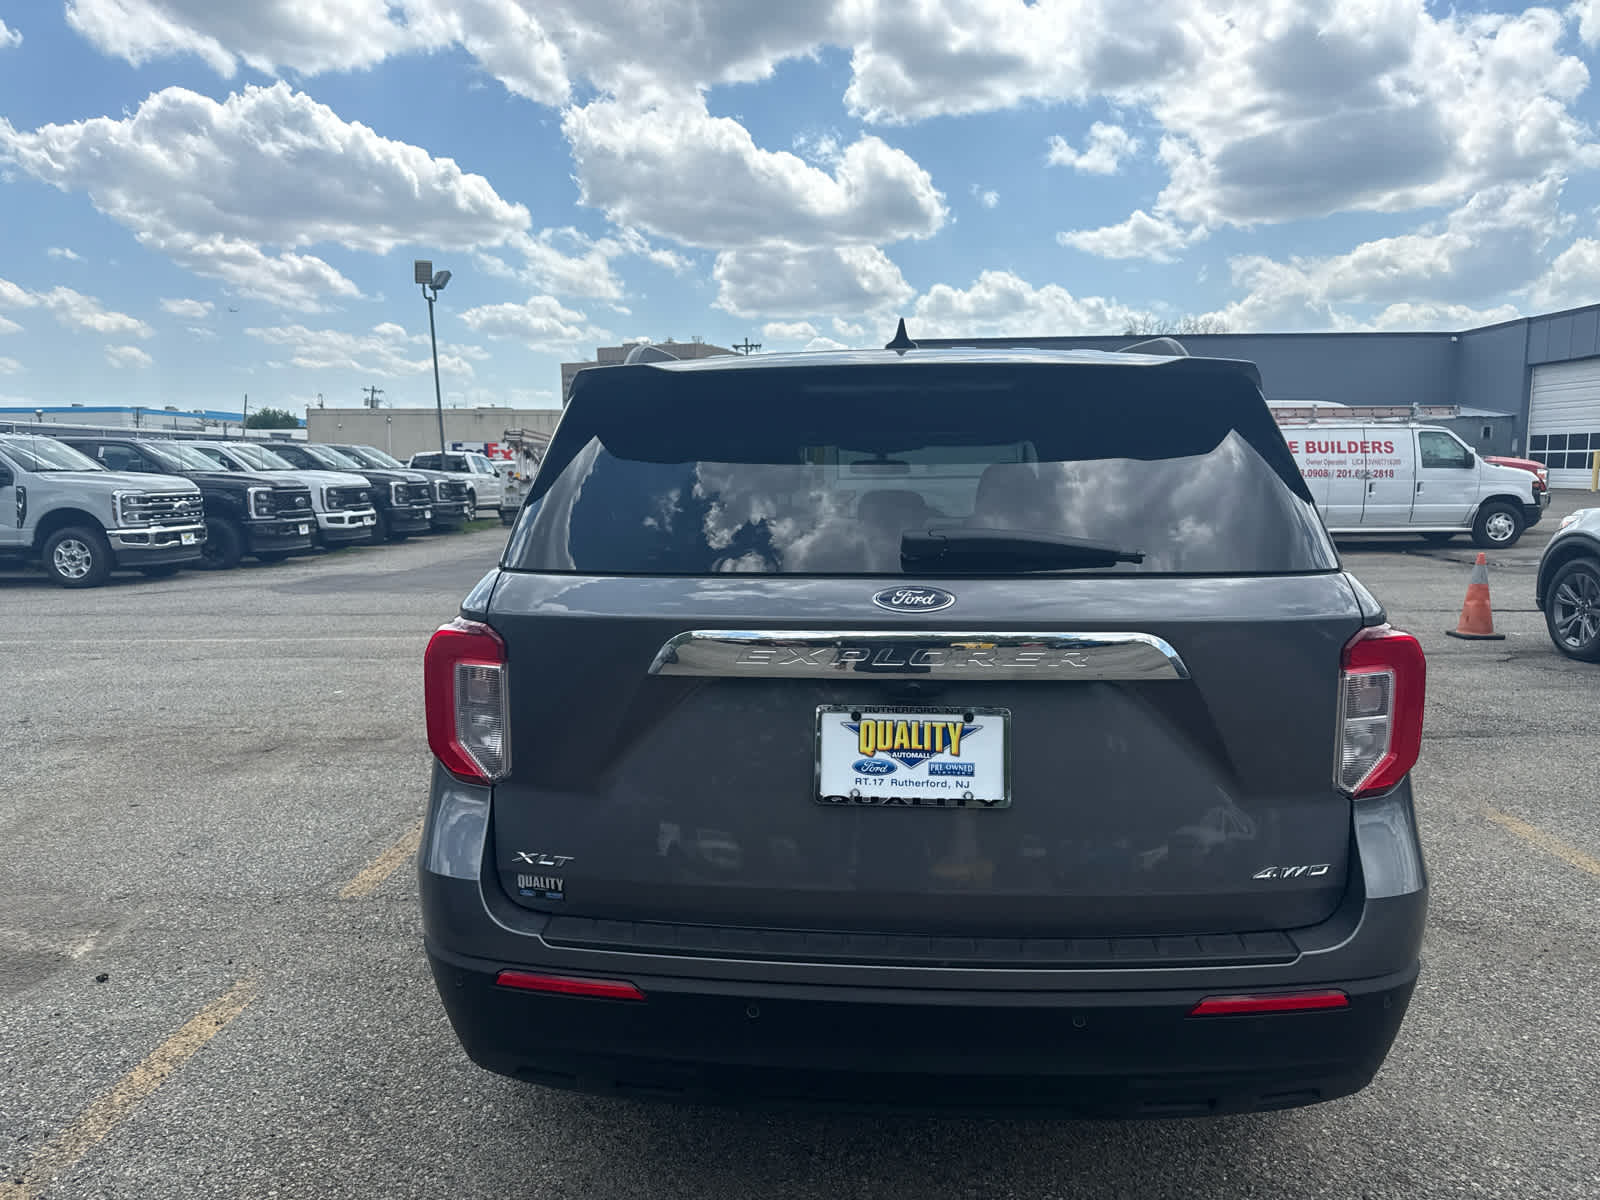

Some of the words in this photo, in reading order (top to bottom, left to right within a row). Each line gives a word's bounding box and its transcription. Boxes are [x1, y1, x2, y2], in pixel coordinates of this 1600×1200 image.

[1305, 441, 1394, 454] BUILDERS
[892, 590, 936, 604] Ford
[735, 648, 1090, 668] EXPLORER
[859, 719, 964, 757] QUALITY
[861, 760, 888, 772] Ford
[890, 779, 951, 788] Rutherford,
[512, 852, 575, 866] XLT
[1252, 864, 1331, 878] 4WD
[517, 874, 563, 891] QUALITY
